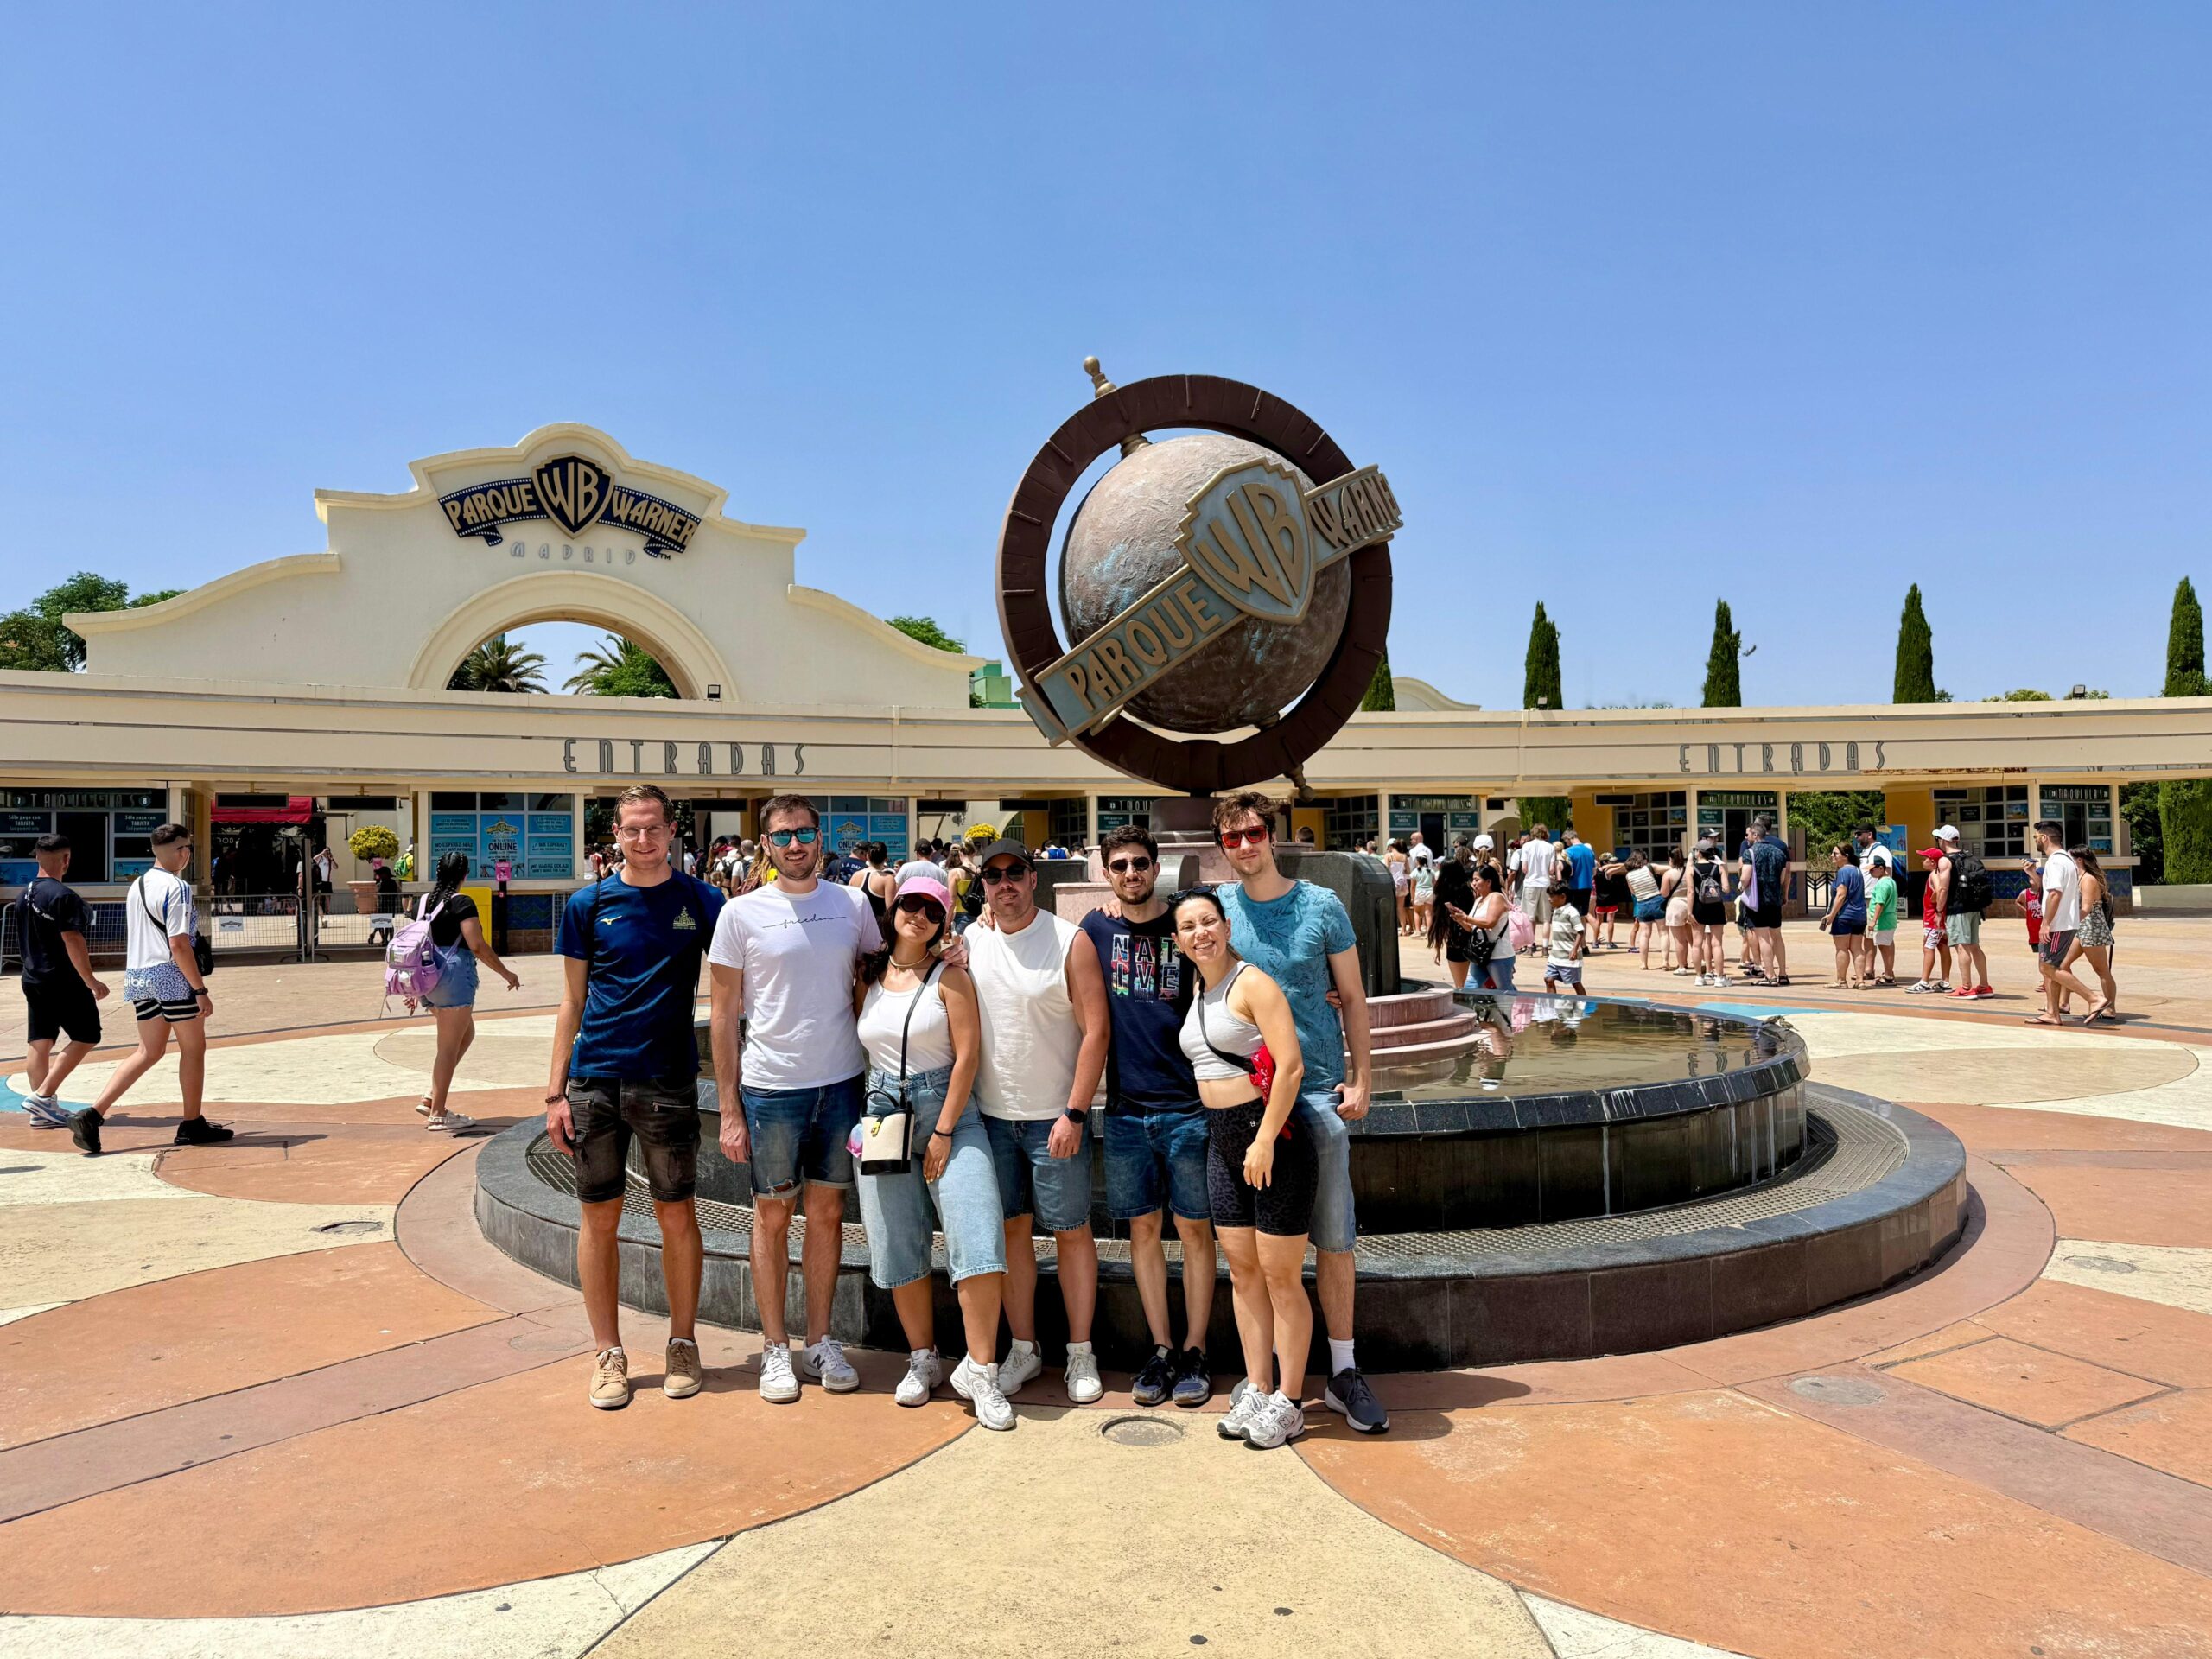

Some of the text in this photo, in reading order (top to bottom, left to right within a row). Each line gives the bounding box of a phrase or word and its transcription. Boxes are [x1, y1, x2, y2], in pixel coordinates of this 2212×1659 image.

[444, 462, 699, 544] PARQUE WB WARNER
[510, 542, 636, 564] MADRID
[1197, 482, 1304, 607] WB
[1062, 578, 1222, 712] PARQUE
[563, 739, 804, 775] ENTRADAS
[1679, 741, 1885, 772] ENTRADAS
